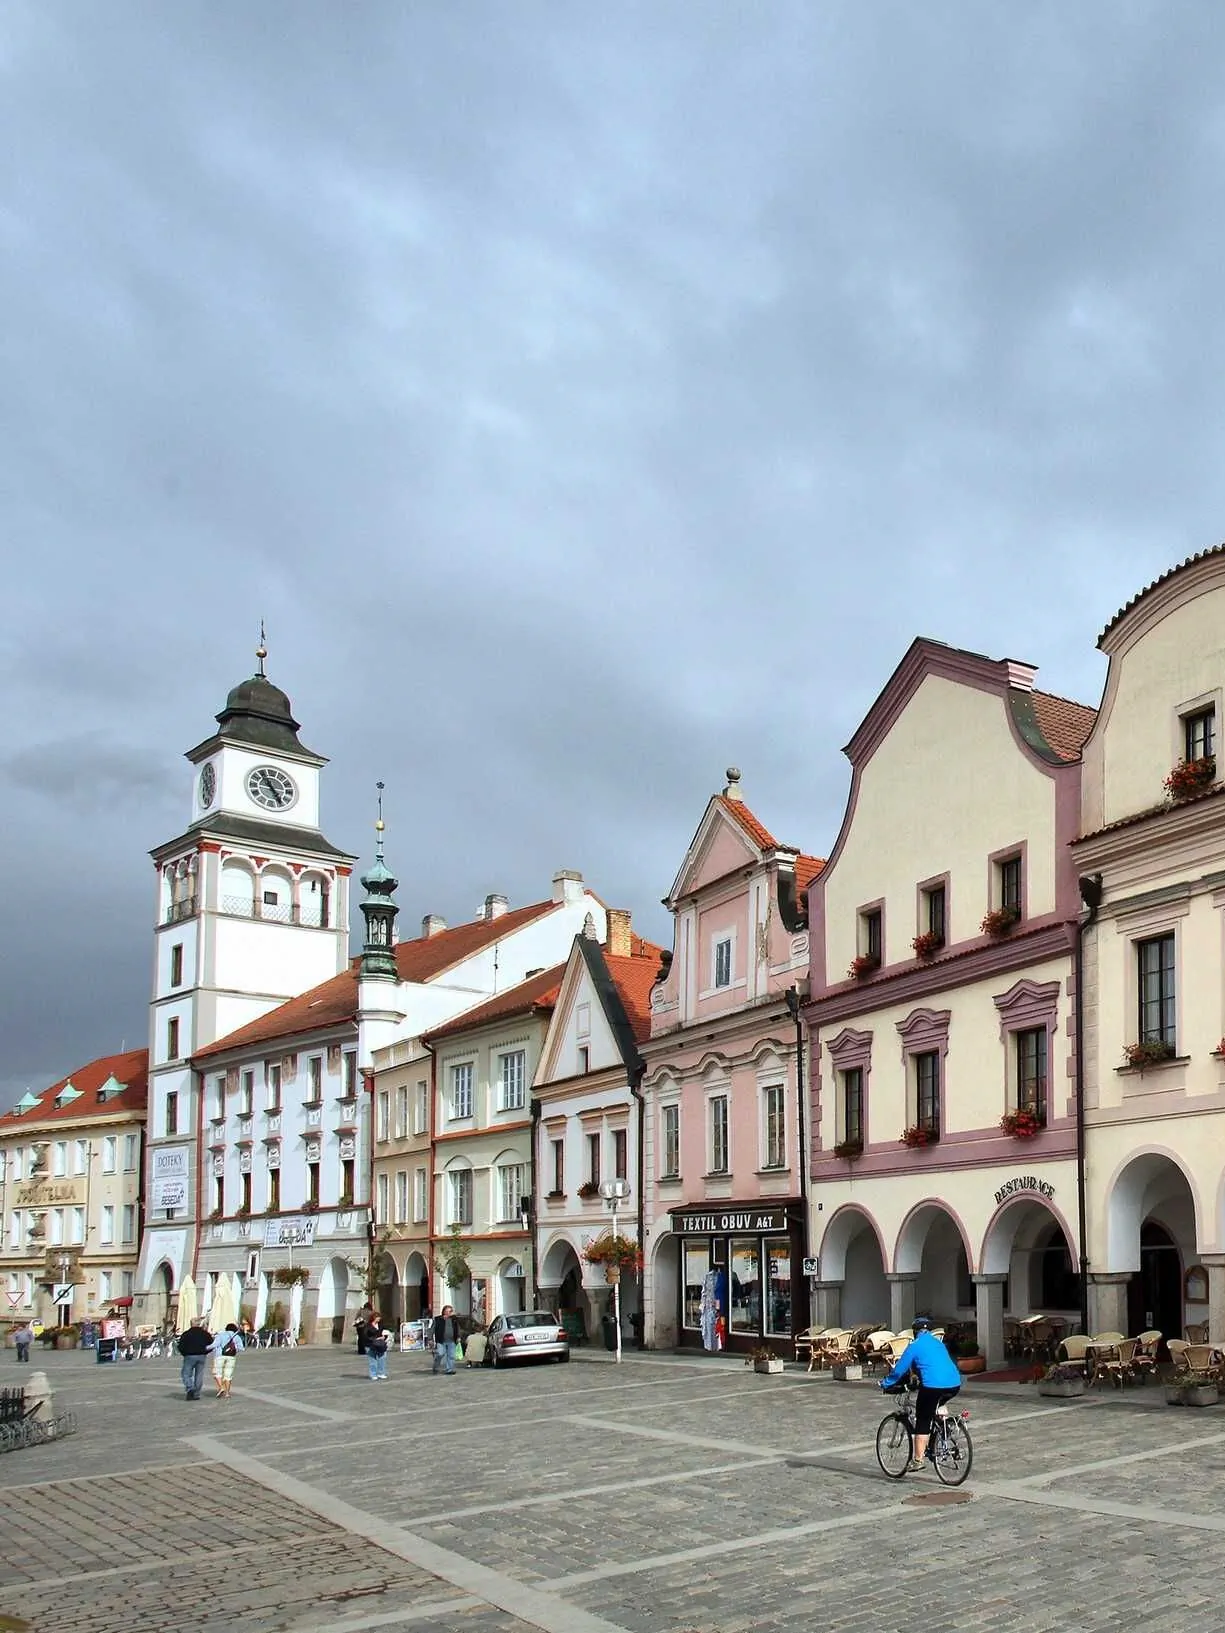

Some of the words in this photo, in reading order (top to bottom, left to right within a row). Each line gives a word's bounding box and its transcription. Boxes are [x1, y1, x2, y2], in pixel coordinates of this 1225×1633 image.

[994, 1176, 1055, 1204] RESTAURACE
[682, 1216, 716, 1231] TEXTIL
[721, 1214, 751, 1229] OBUV
[756, 1215, 773, 1228] A&T
